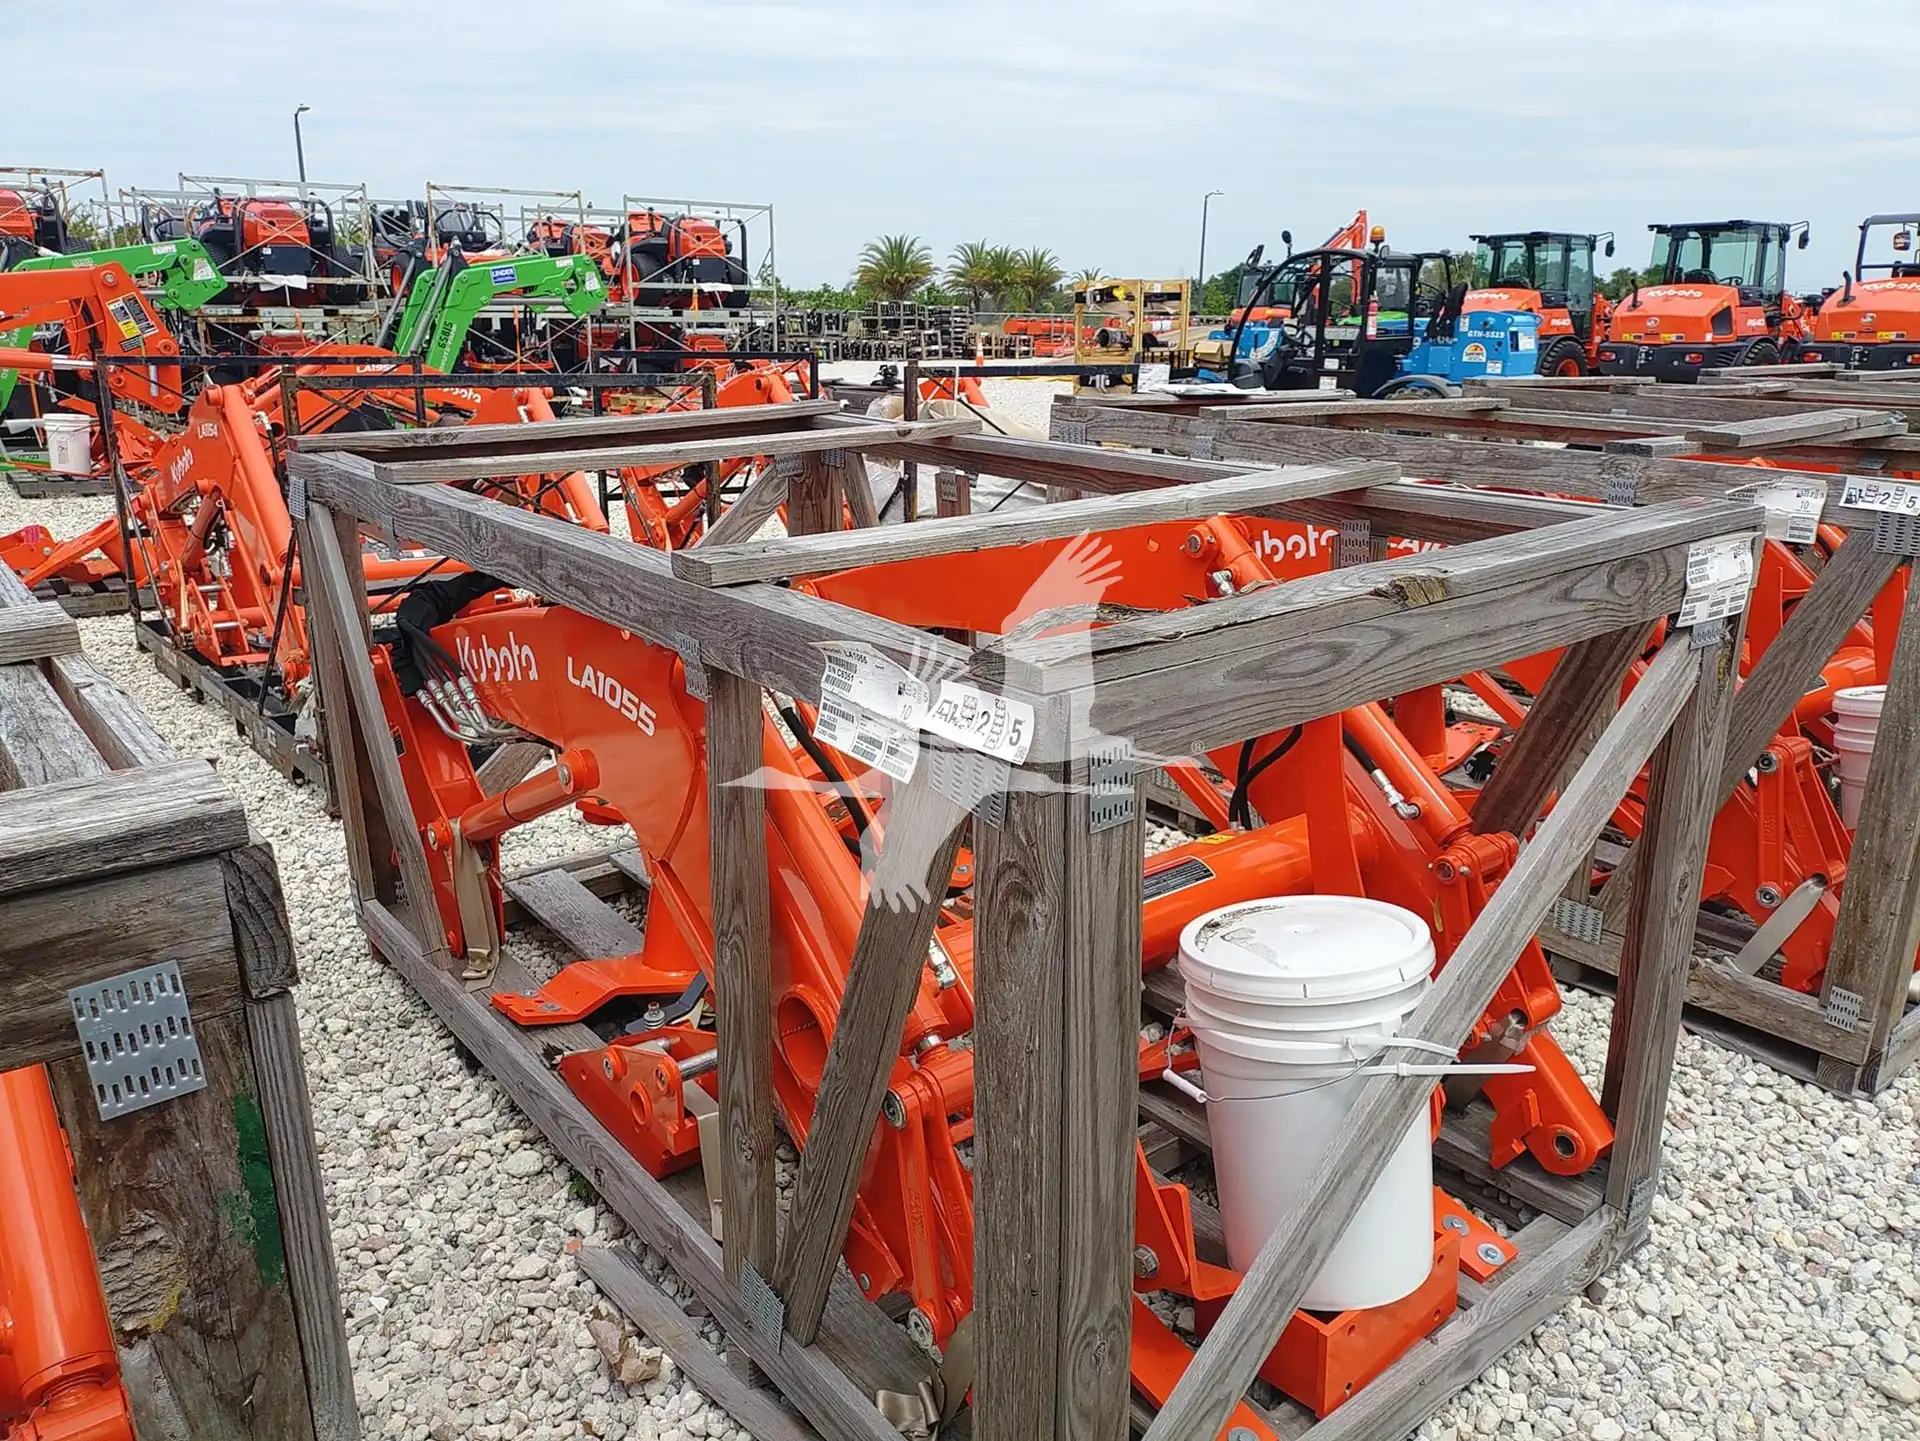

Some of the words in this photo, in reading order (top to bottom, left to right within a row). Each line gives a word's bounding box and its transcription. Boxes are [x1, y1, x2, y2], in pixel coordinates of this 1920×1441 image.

[1647, 288, 1704, 298] Kubota
[170, 445, 194, 485] Kubota
[1800, 500, 1810, 510] 10
[1879, 491, 1891, 505] 2
[1906, 496, 1918, 509] 5
[455, 631, 539, 684] Kubota
[567, 656, 657, 737] LA1055
[900, 703, 913, 721] 10
[975, 710, 991, 733] 2
[1008, 718, 1024, 747] 5
